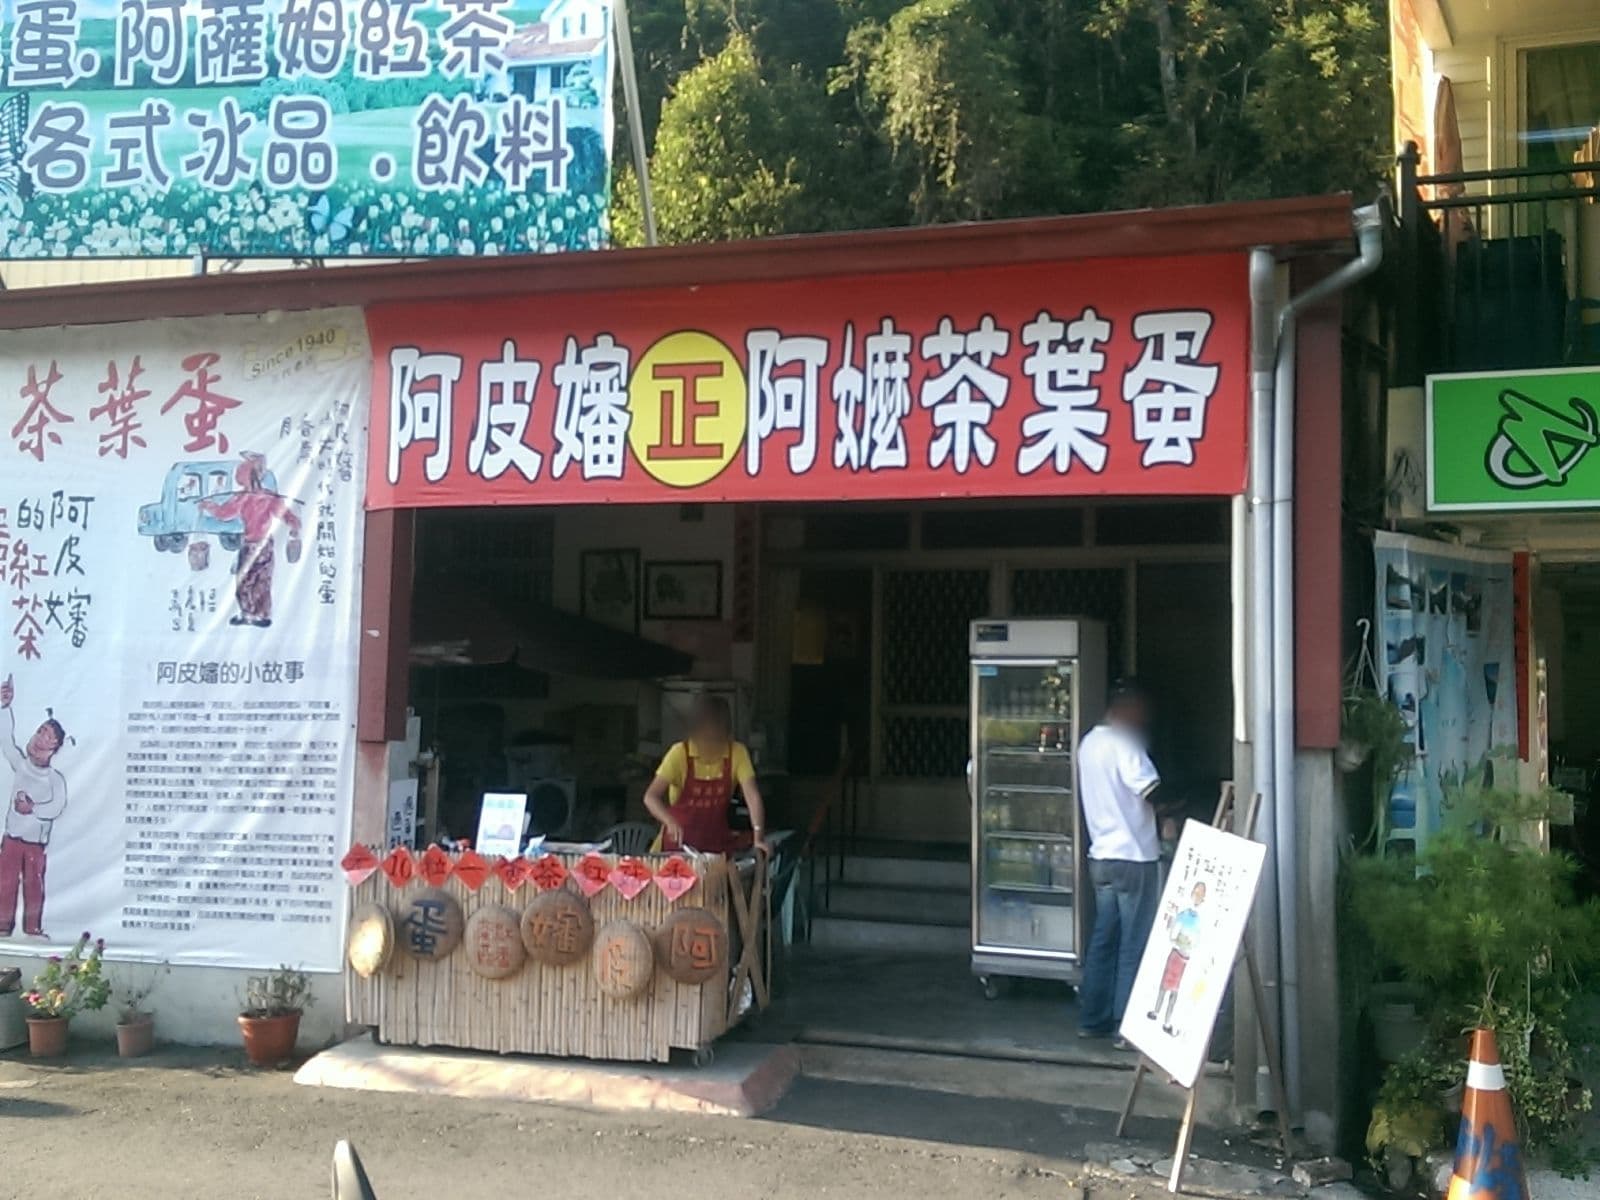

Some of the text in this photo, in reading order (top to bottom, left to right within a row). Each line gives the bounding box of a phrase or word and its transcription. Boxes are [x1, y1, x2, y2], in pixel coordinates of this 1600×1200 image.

[11, 354, 243, 462] 茶葉蛋
[388, 335, 632, 482] 阿皮嬸
[646, 360, 724, 460] 正
[157, 661, 304, 684] 阿皮嬸的小故事
